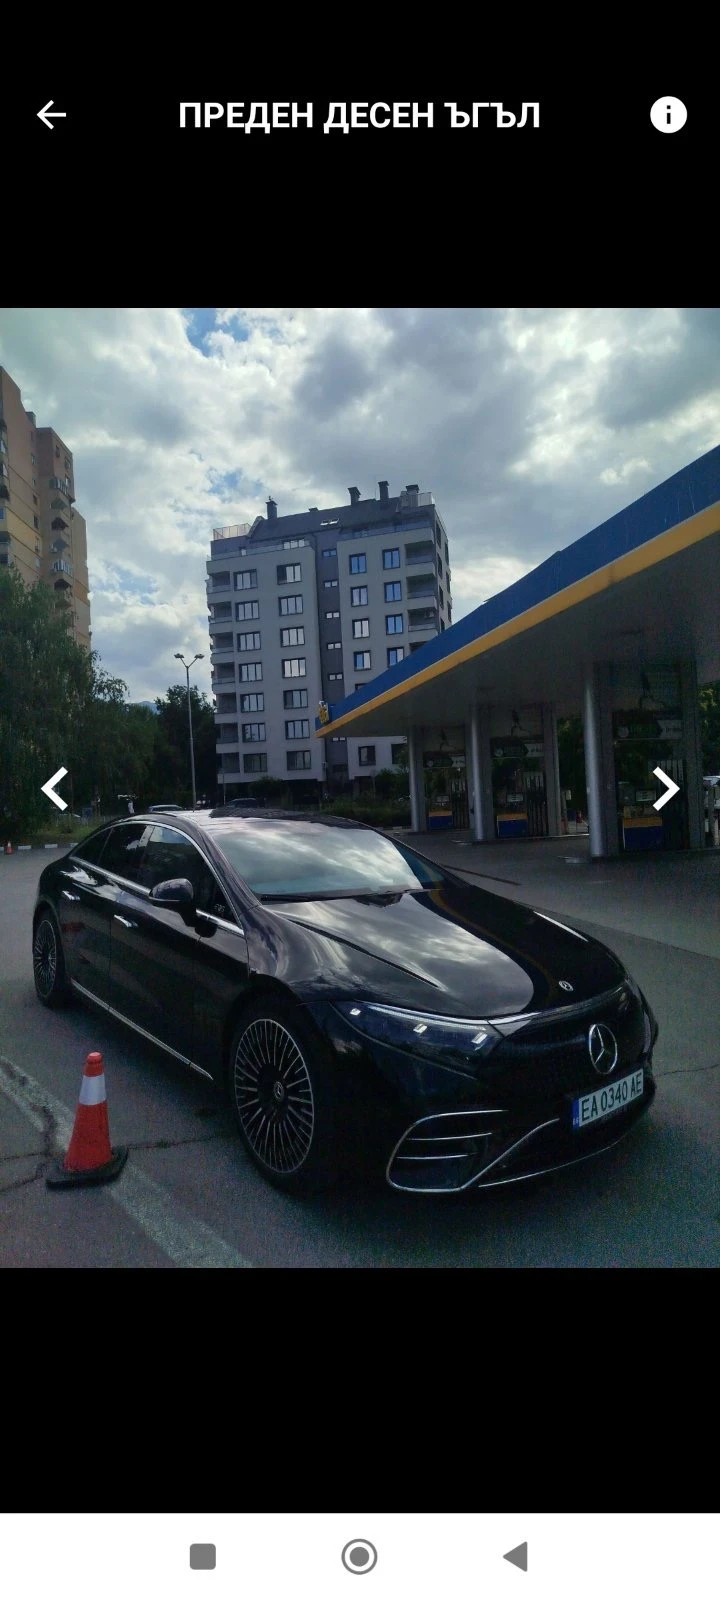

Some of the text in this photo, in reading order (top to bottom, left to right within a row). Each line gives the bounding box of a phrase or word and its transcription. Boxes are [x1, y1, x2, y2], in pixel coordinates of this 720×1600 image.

[581, 1072, 642, 1122] EA 0340 AE
